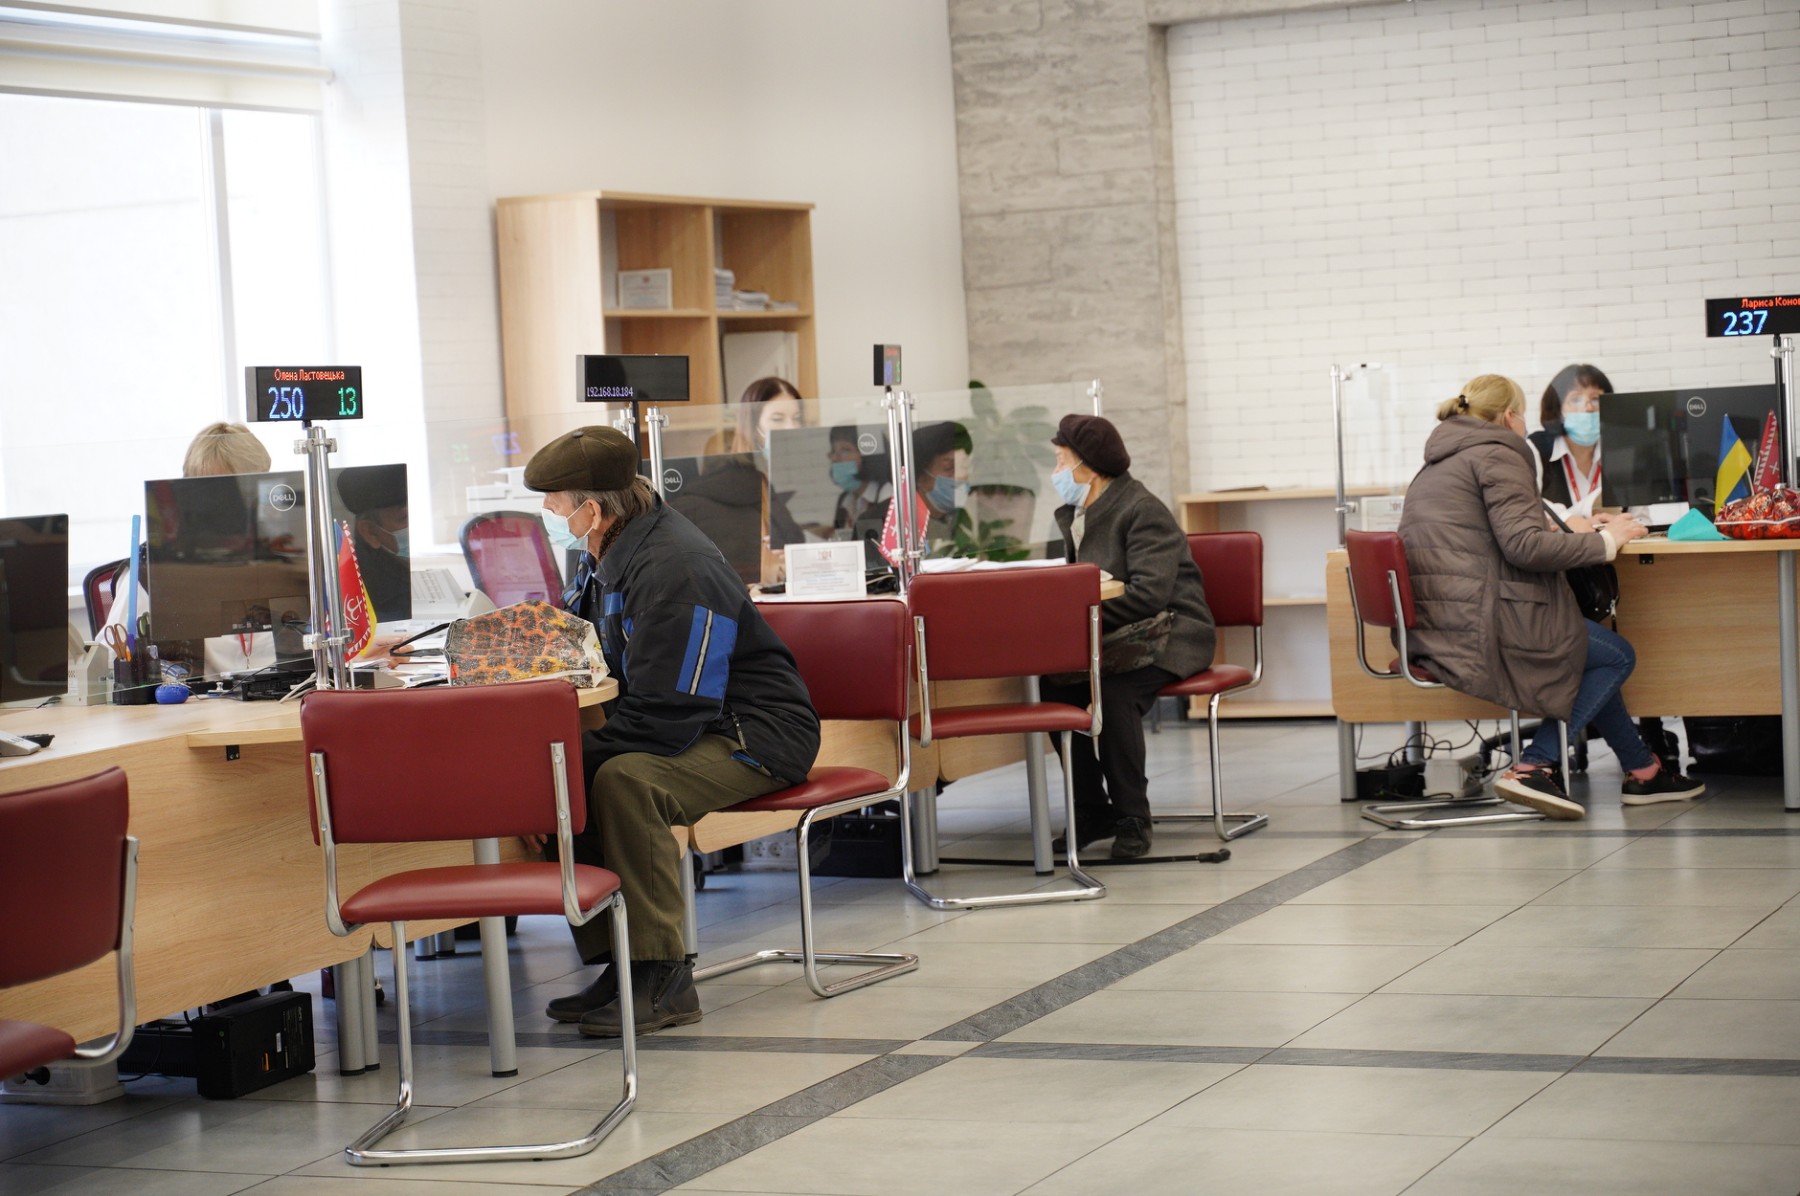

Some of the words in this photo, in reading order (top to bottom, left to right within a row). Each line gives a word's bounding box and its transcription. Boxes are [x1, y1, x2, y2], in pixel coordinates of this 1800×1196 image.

[1741, 298, 1774, 310] Лариса
[1723, 310, 1768, 336] 237
[274, 368, 298, 381] Олена
[586, 386, 634, 397] 192.168.18.184
[268, 386, 304, 419] 250
[338, 387, 357, 416] 13
[272, 493, 294, 502] DELL
